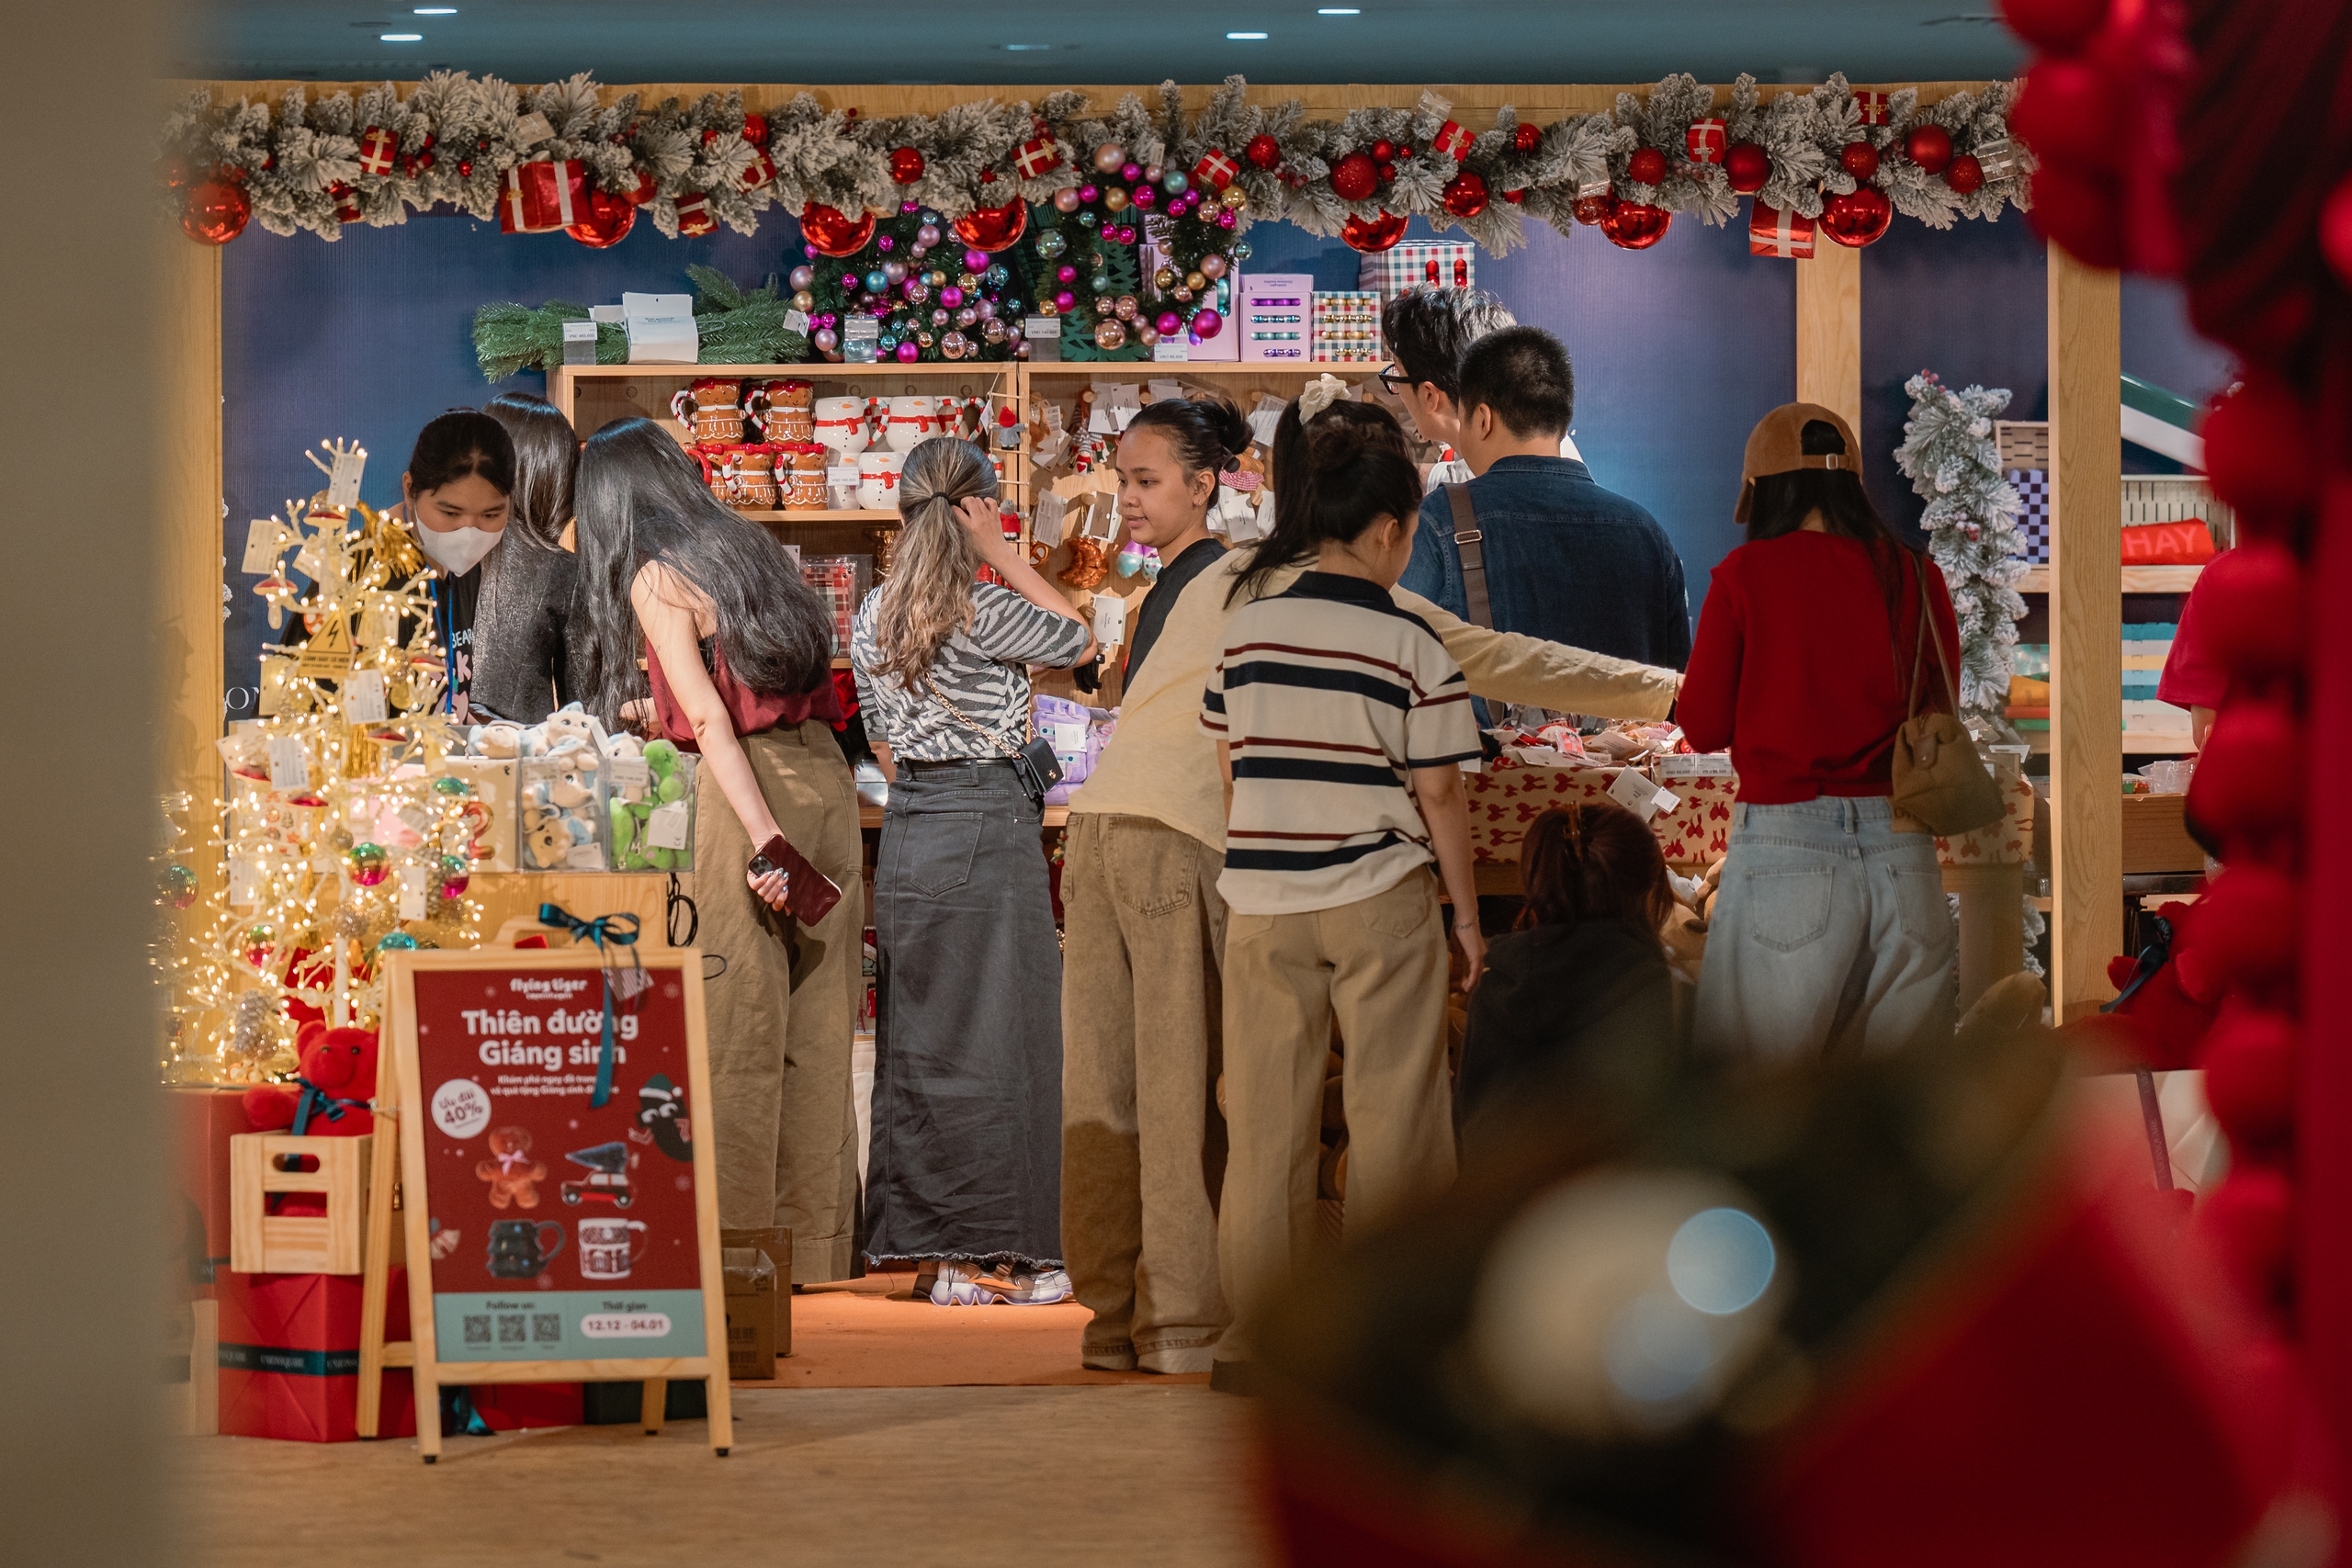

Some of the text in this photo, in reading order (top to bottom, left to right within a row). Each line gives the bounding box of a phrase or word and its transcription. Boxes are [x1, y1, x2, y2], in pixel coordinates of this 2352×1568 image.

[2123, 526, 2197, 557] HAY
[510, 977, 588, 993] flying tiger
[461, 1009, 541, 1035] Thiên
[479, 1039, 562, 1071] Giáng
[445, 1100, 484, 1123] 40%
[485, 1301, 518, 1310] Follow
[588, 1319, 621, 1331] 12.12
[630, 1318, 663, 1330] 04.01
